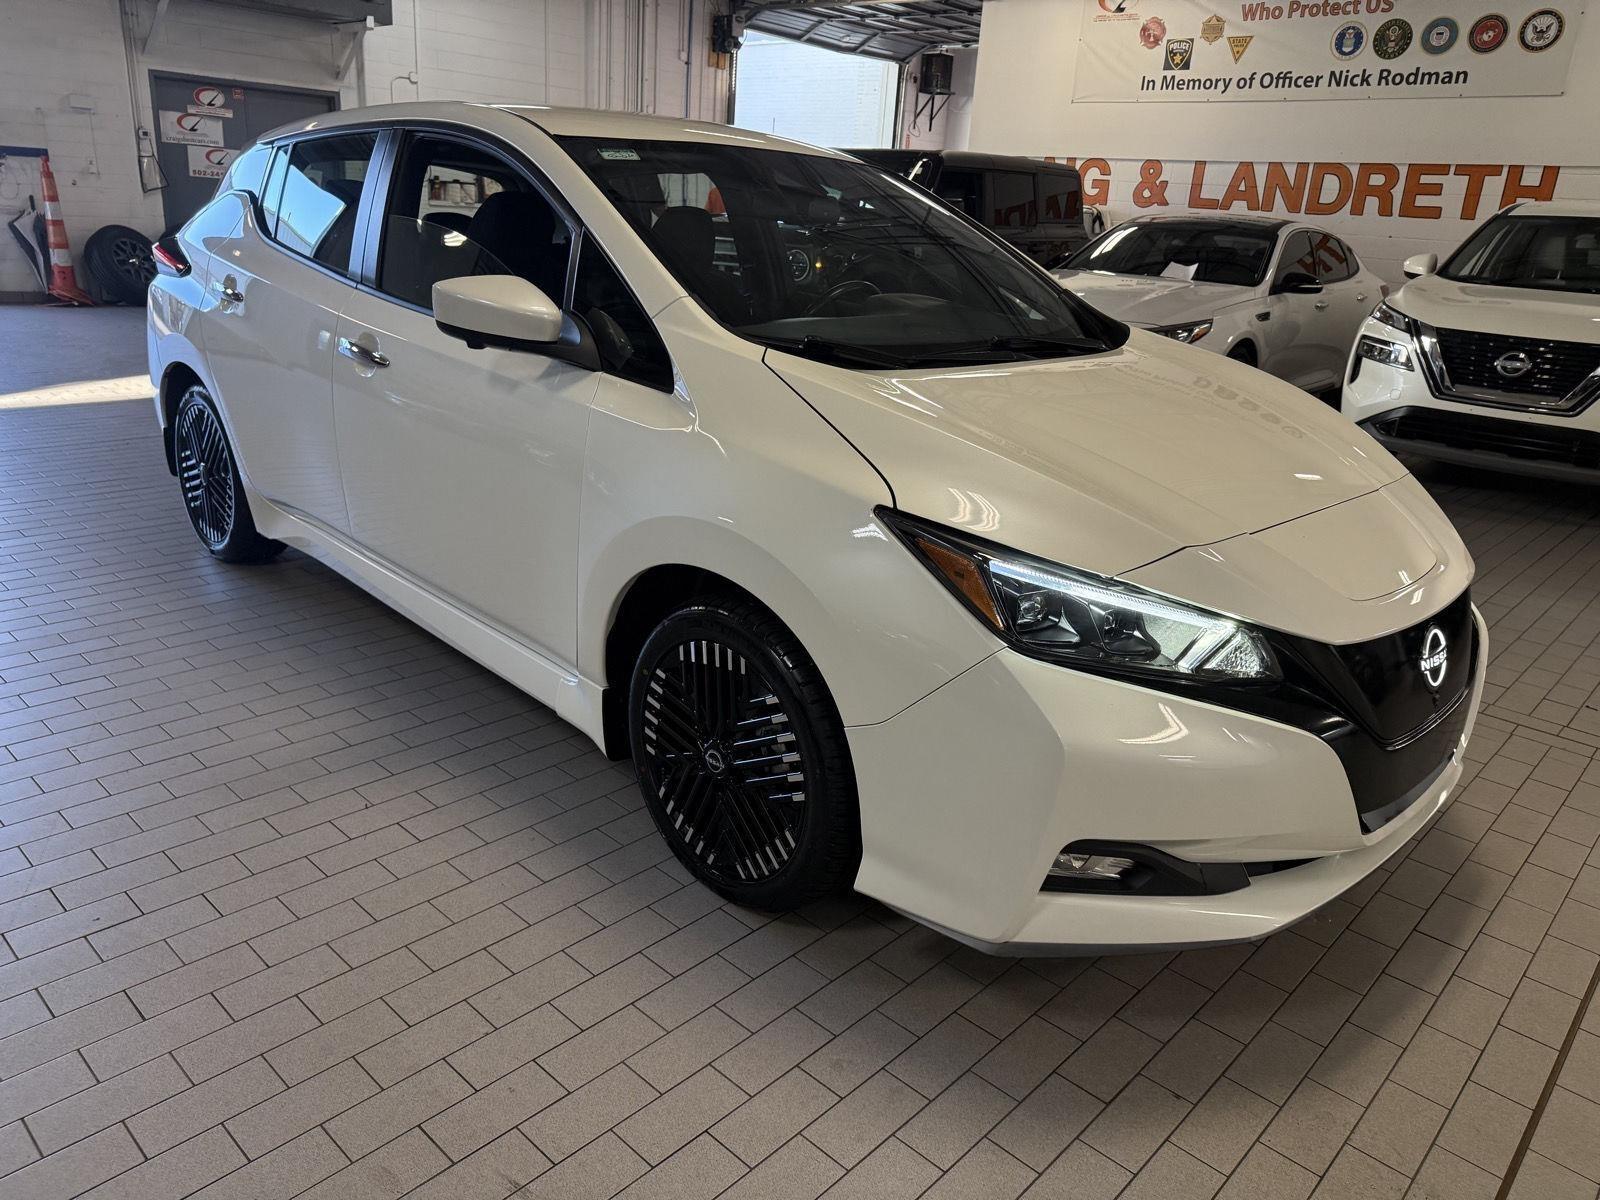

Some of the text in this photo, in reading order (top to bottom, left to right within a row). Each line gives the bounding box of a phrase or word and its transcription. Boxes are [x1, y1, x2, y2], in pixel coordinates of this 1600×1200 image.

[1241, 0, 1395, 21] Who Protect US
[1169, 41, 1190, 51] POLICE
[1140, 66, 1468, 94] In Memory of Officer Nick Rodman
[1132, 159, 1169, 208] &
[1188, 161, 1560, 220] LANDRETH
